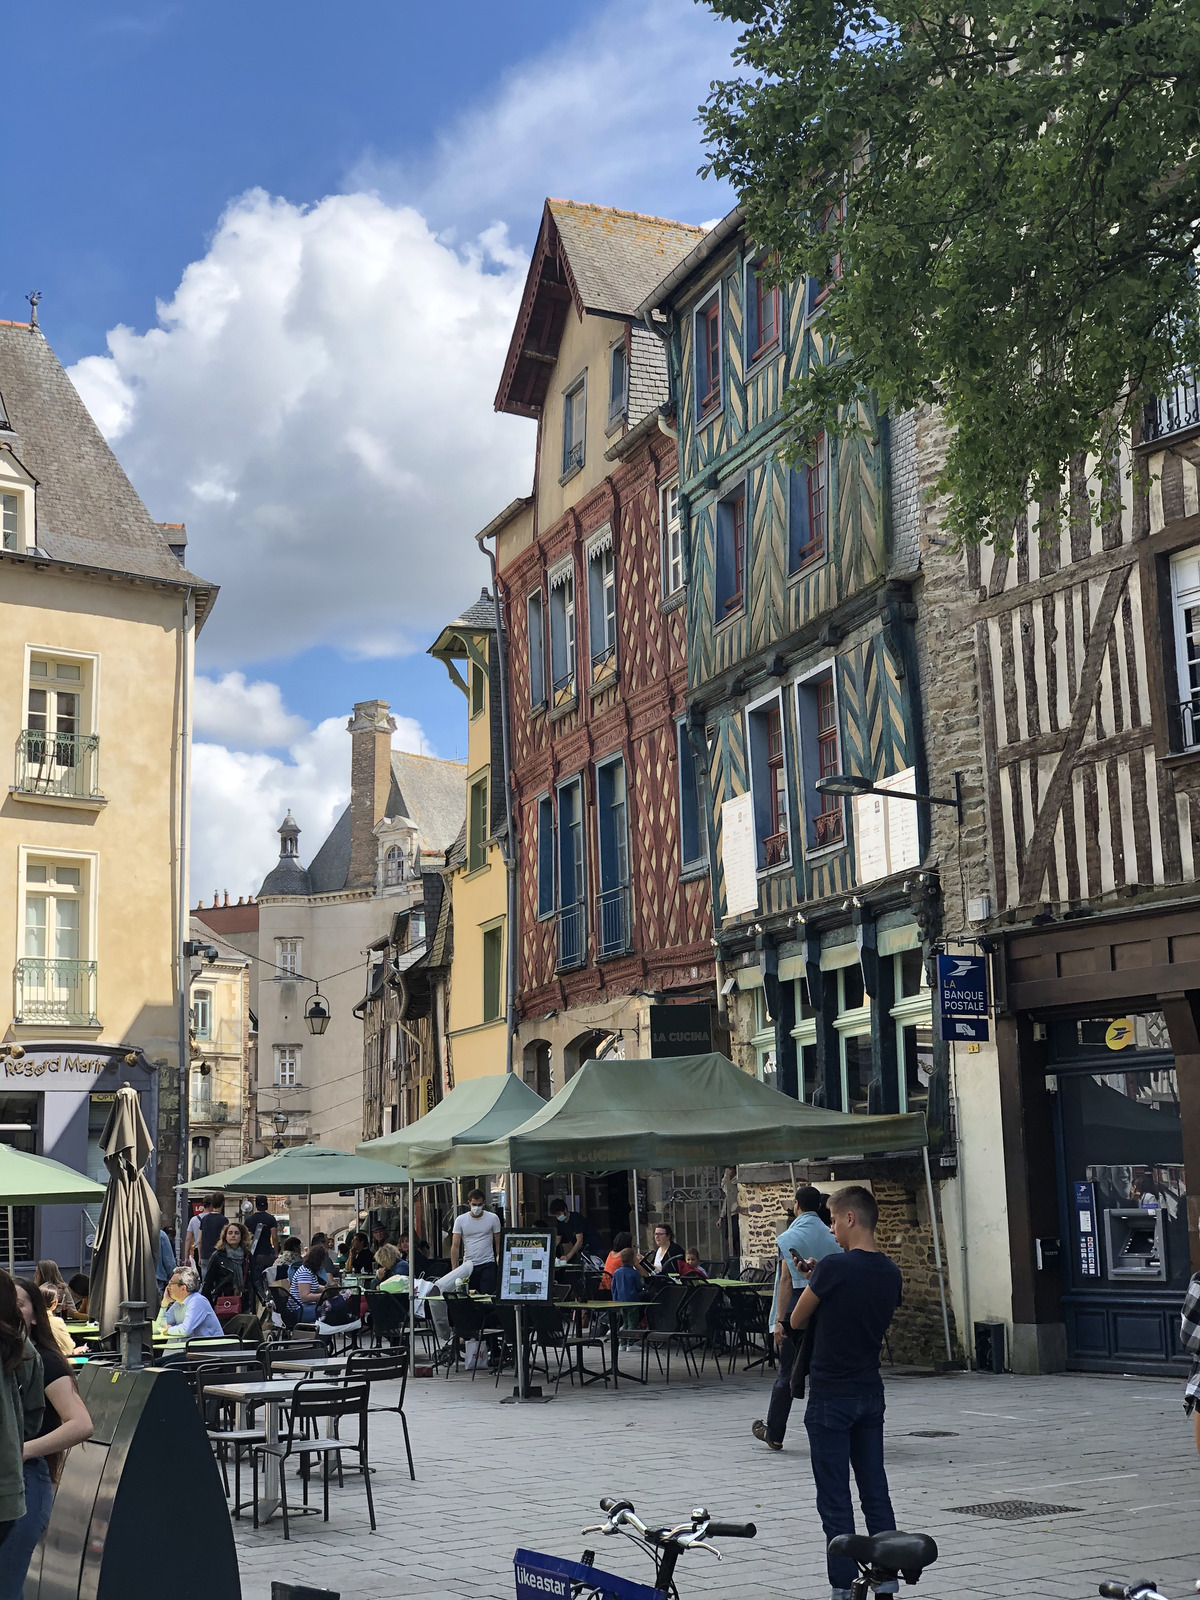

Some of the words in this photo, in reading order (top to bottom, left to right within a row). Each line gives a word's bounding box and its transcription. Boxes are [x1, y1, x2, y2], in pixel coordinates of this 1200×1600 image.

[944, 980, 956, 988] LA
[944, 990, 984, 1000] BANQUE
[944, 1001, 984, 1010] POSTALE
[653, 1032, 666, 1042] LA
[668, 1031, 710, 1042] CUCINA
[5, 1055, 61, 1077] Regard
[556, 1151, 574, 1162] LA
[577, 1149, 632, 1162] CUCINA
[515, 1239, 538, 1248] PIZZAS
[516, 1565, 566, 1596] likeastar
